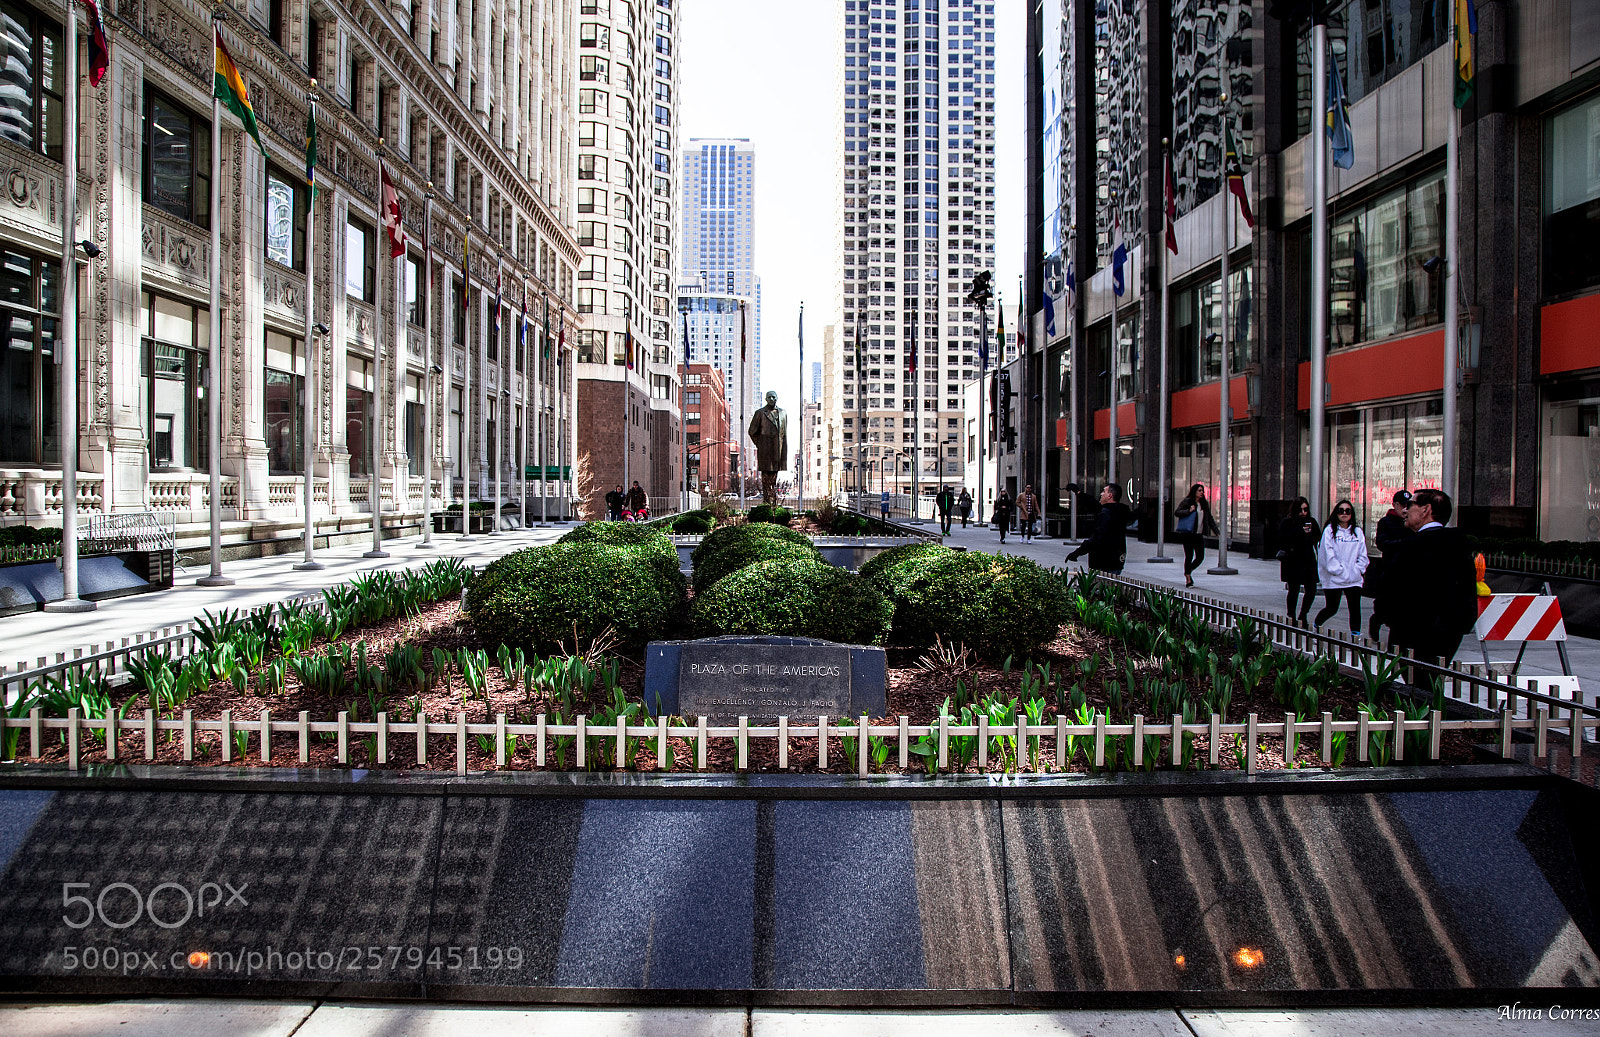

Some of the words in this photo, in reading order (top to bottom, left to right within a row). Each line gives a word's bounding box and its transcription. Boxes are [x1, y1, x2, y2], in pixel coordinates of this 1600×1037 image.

[691, 663, 725, 675] PLAZA
[732, 664, 749, 675] OF
[755, 664, 776, 676] THE
[782, 665, 840, 677] AMERICAS
[761, 699, 798, 707] GONZALO
